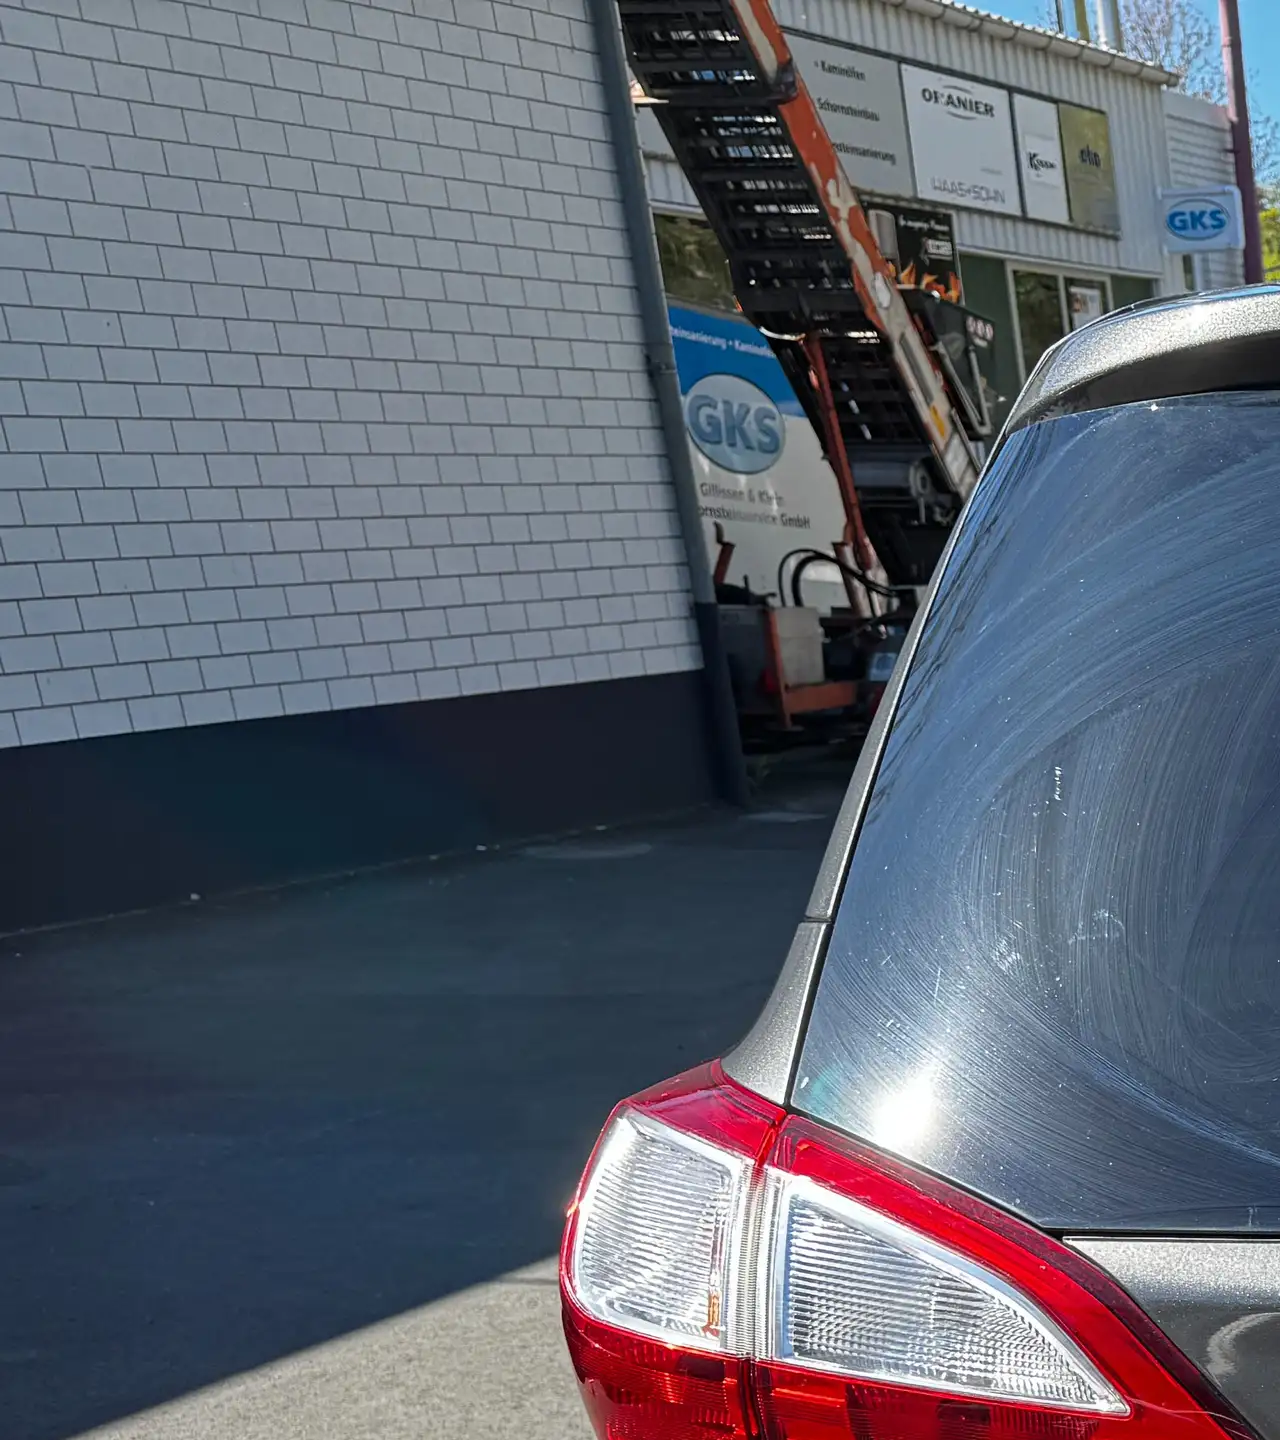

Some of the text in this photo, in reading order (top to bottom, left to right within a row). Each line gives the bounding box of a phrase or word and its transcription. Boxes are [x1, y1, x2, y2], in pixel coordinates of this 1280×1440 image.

[1168, 209, 1226, 231] GKS
[688, 394, 781, 455] GKS
[780, 513, 811, 530] GmbH
